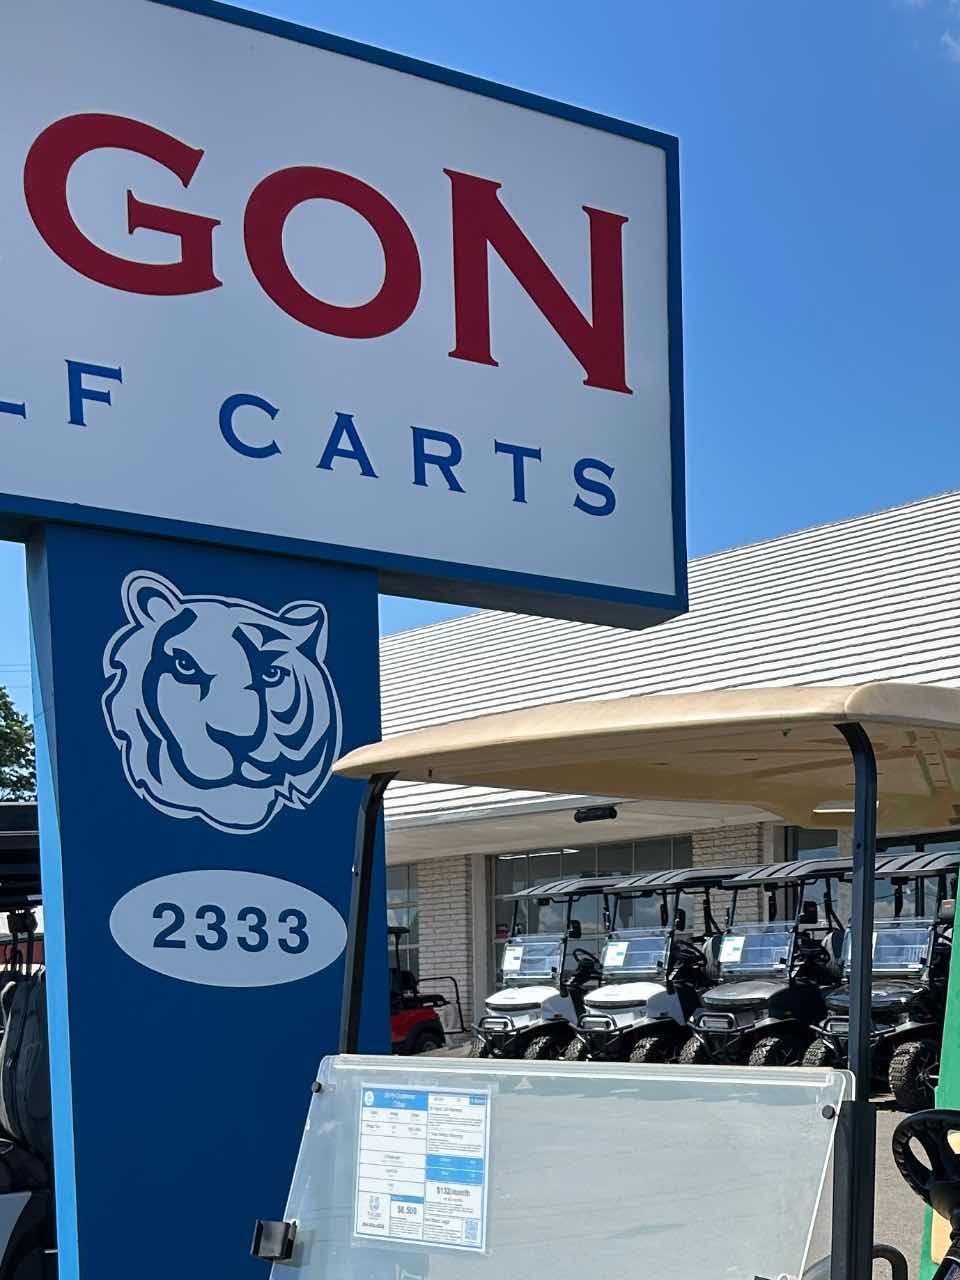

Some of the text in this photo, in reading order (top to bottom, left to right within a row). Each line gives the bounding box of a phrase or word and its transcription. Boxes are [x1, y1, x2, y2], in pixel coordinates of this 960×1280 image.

[23, 113, 634, 394] GON
[218, 393, 617, 517] CARTS
[152, 902, 310, 955] 2333
